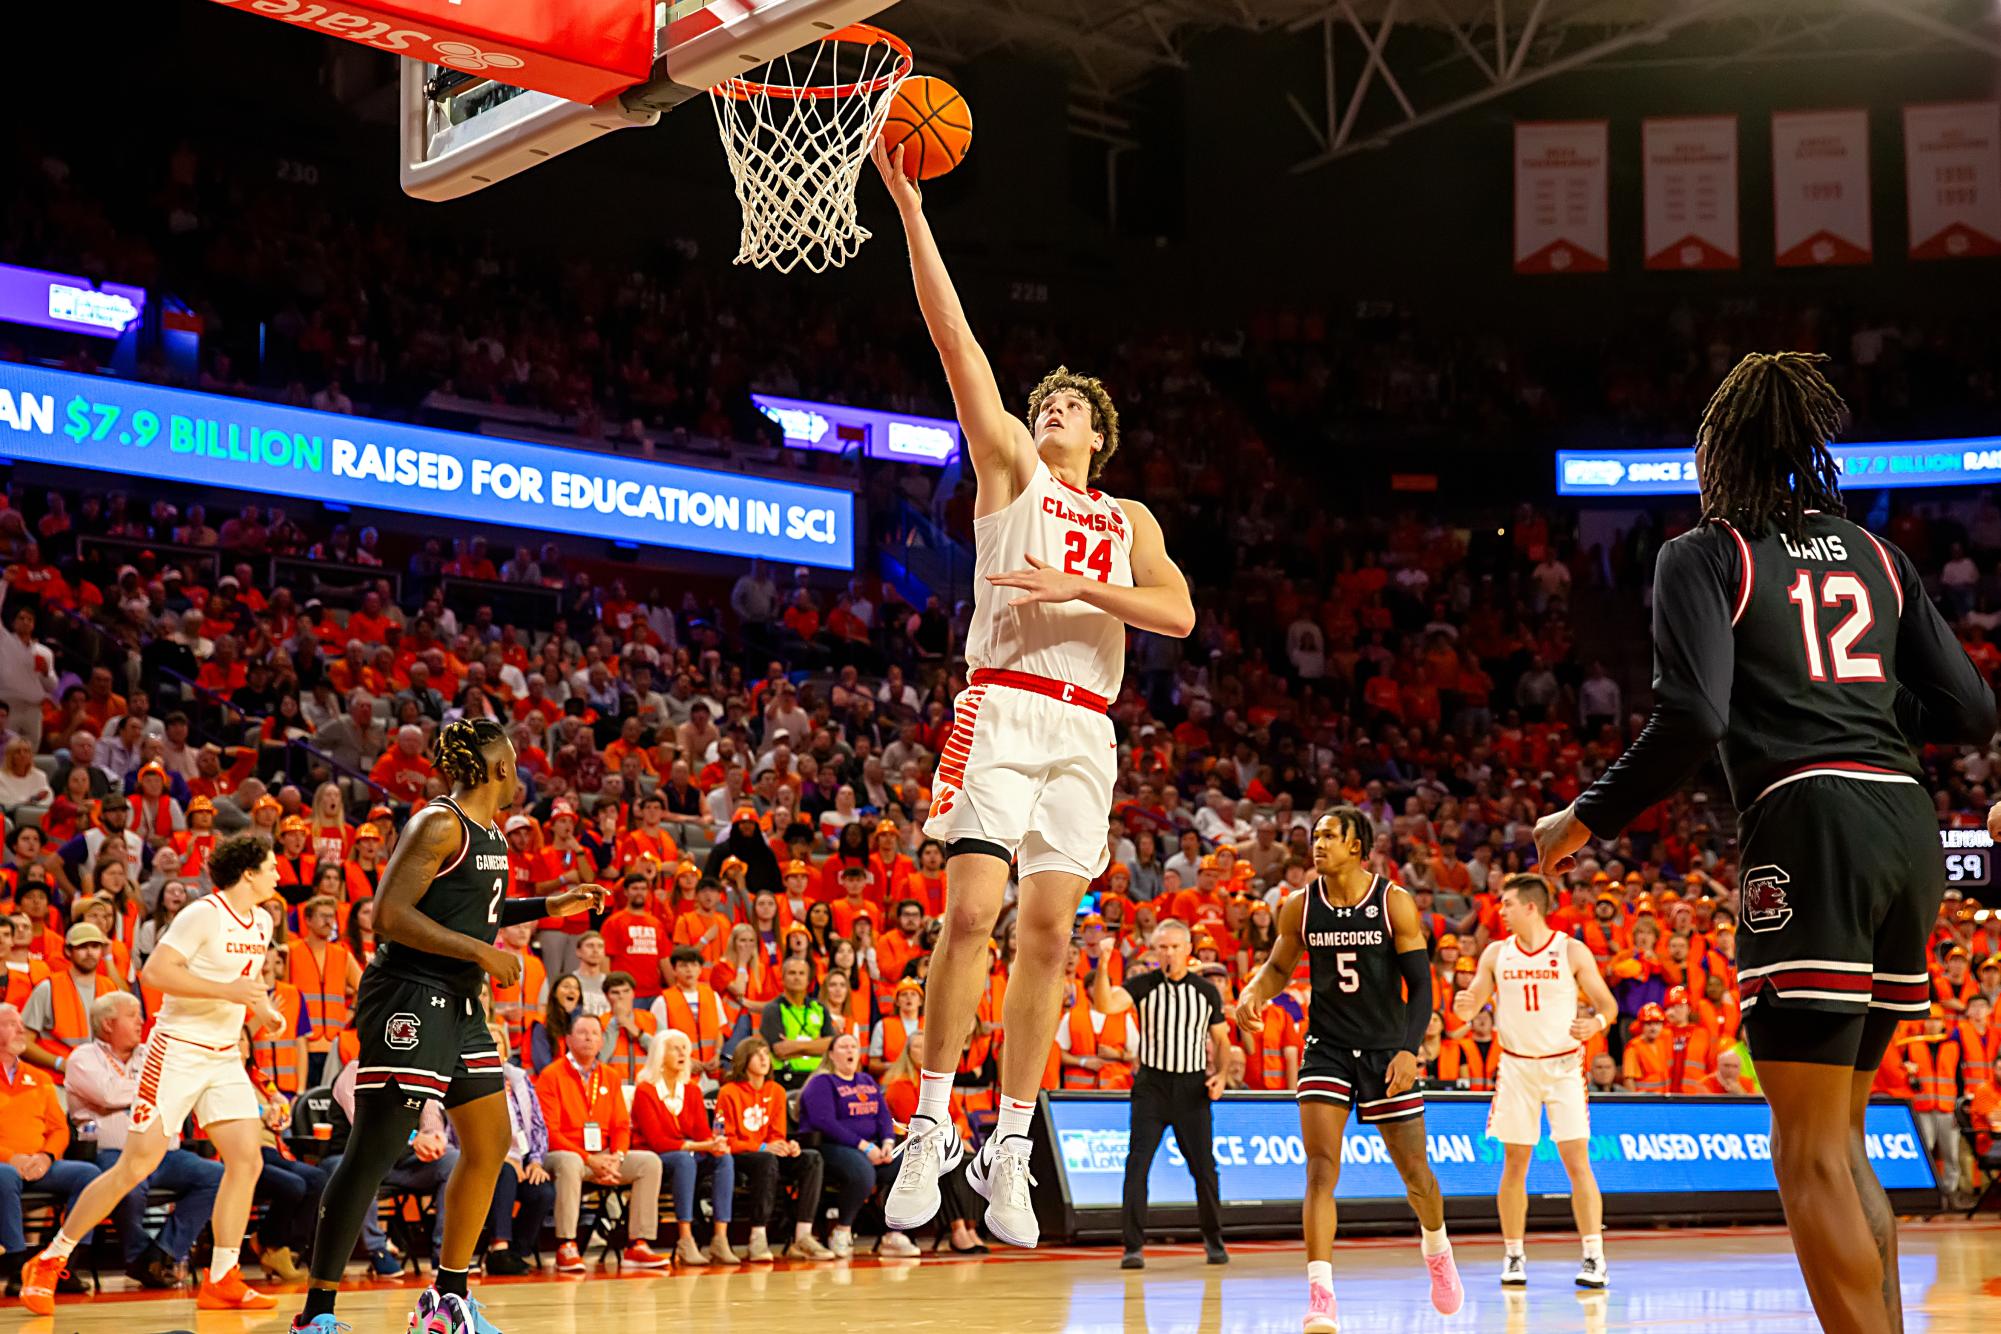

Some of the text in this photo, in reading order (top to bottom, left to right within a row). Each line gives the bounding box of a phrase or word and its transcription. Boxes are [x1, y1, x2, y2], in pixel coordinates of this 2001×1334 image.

[277, 159, 319, 184] 230
[64, 394, 161, 443] $7.9
[171, 415, 323, 472] BILLION
[332, 438, 464, 491] RAISED
[472, 458, 544, 504] FOR
[552, 471, 740, 530] EDUCATION
[746, 499, 780, 537] IN
[786, 505, 836, 544] SC!
[1889, 453, 1961, 474] BILLION
[1064, 530, 1113, 584] 24
[1787, 568, 1887, 684] 12
[1940, 830, 1994, 848] LEMSON
[1945, 854, 1982, 881] 59
[487, 878, 503, 923] 2
[1308, 930, 1383, 947] GAMECOCKS
[1336, 952, 1360, 993] 5
[1503, 969, 1559, 980] CLEMSON
[1524, 984, 1540, 1012] 11
[1165, 1135, 1248, 1166] SCE
[1426, 1133, 1476, 1163] HAN
[1619, 1133, 1699, 1162] RAISED
[1701, 1133, 1748, 1161] FOR
[1882, 1133, 1919, 1160] SC!
